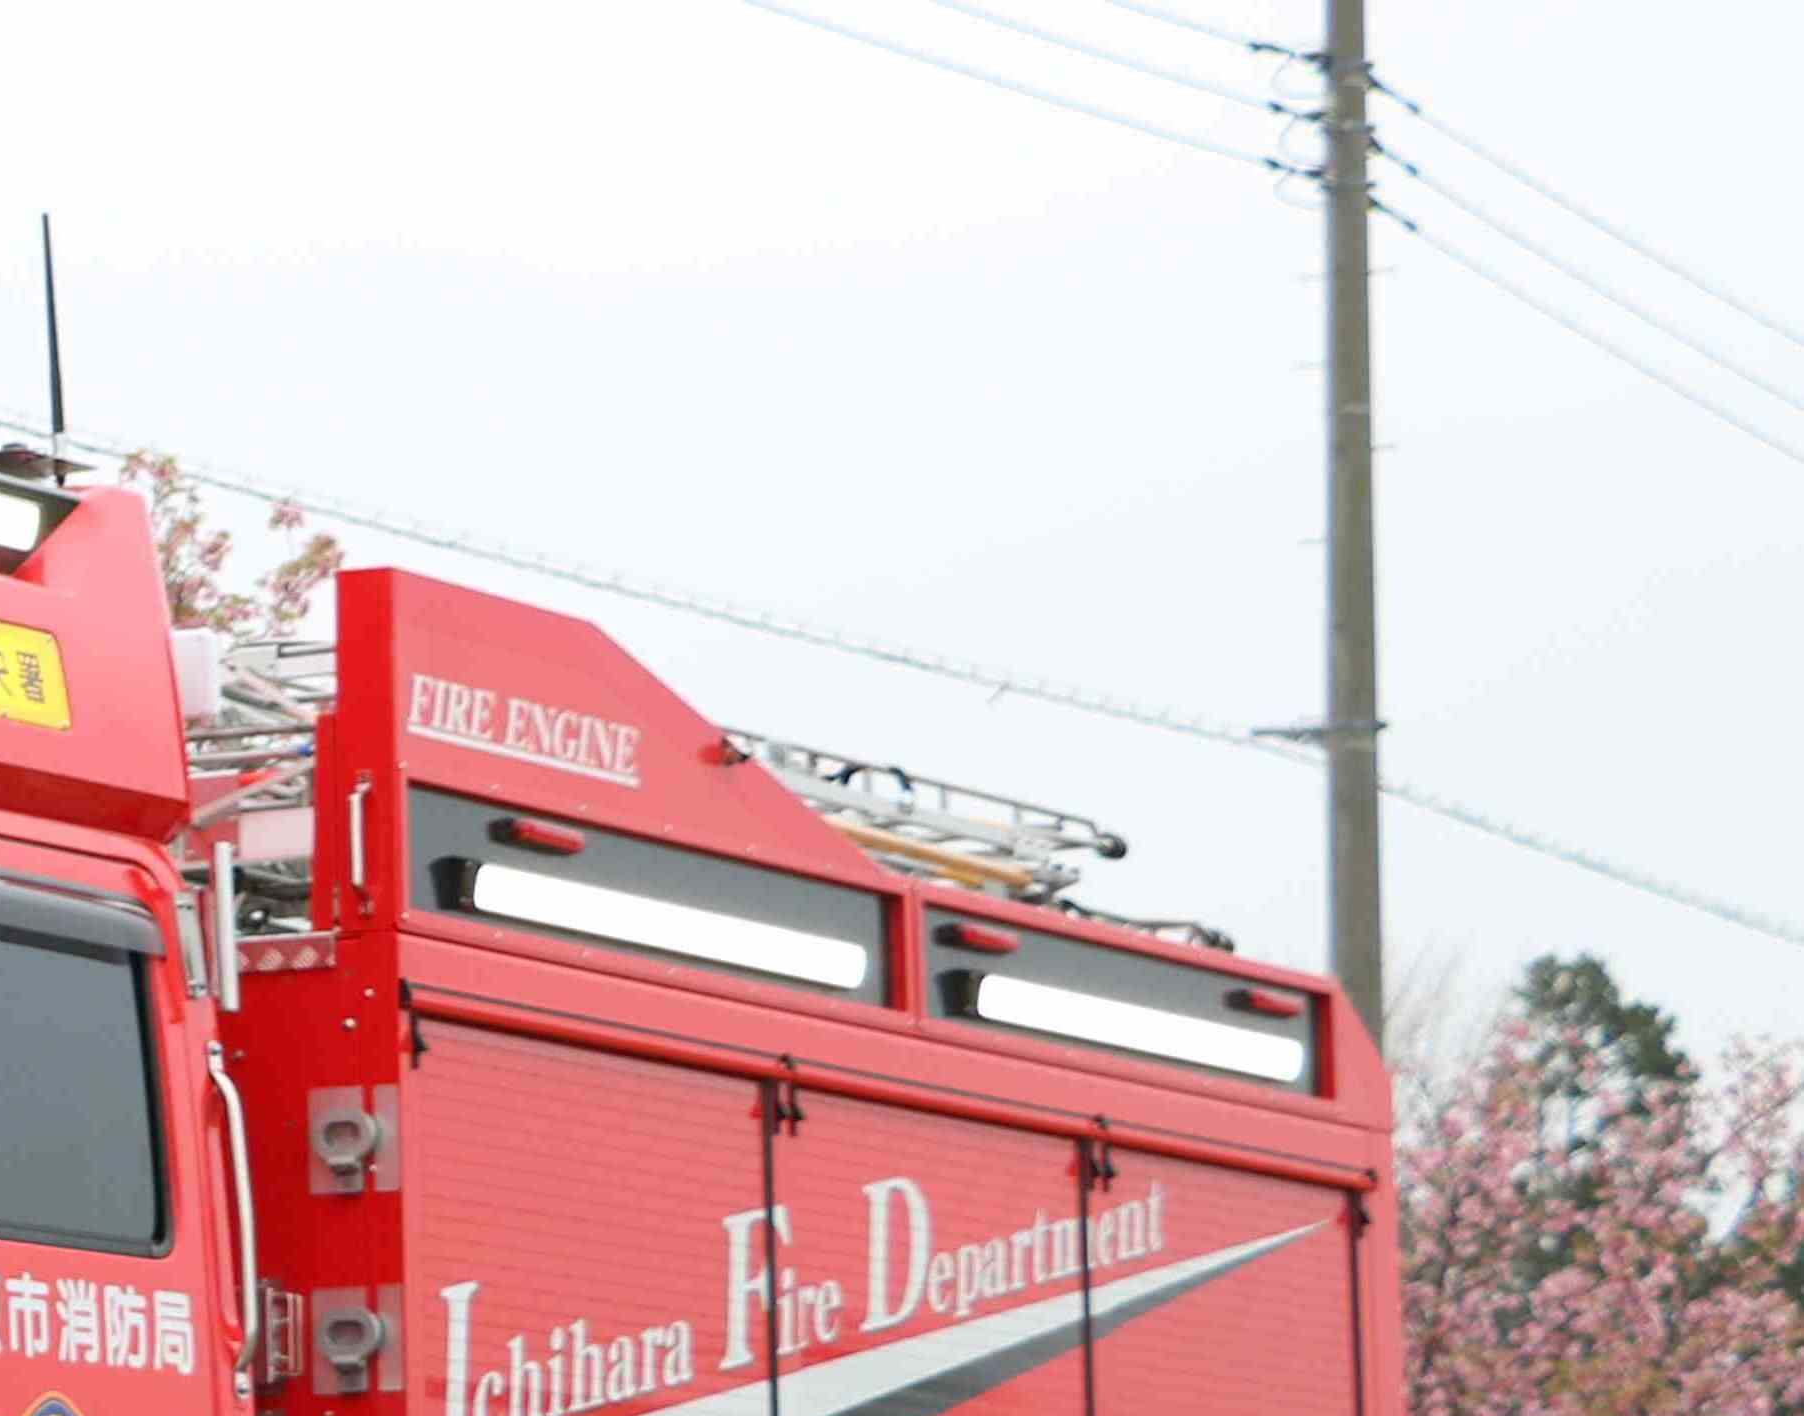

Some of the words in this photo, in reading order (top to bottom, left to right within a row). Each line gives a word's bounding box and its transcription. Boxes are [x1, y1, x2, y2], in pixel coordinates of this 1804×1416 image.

[408, 673, 496, 739] FIRE
[503, 697, 641, 774] ENGINE
[718, 1204, 843, 1370] Fire
[859, 1176, 1168, 1332] Department
